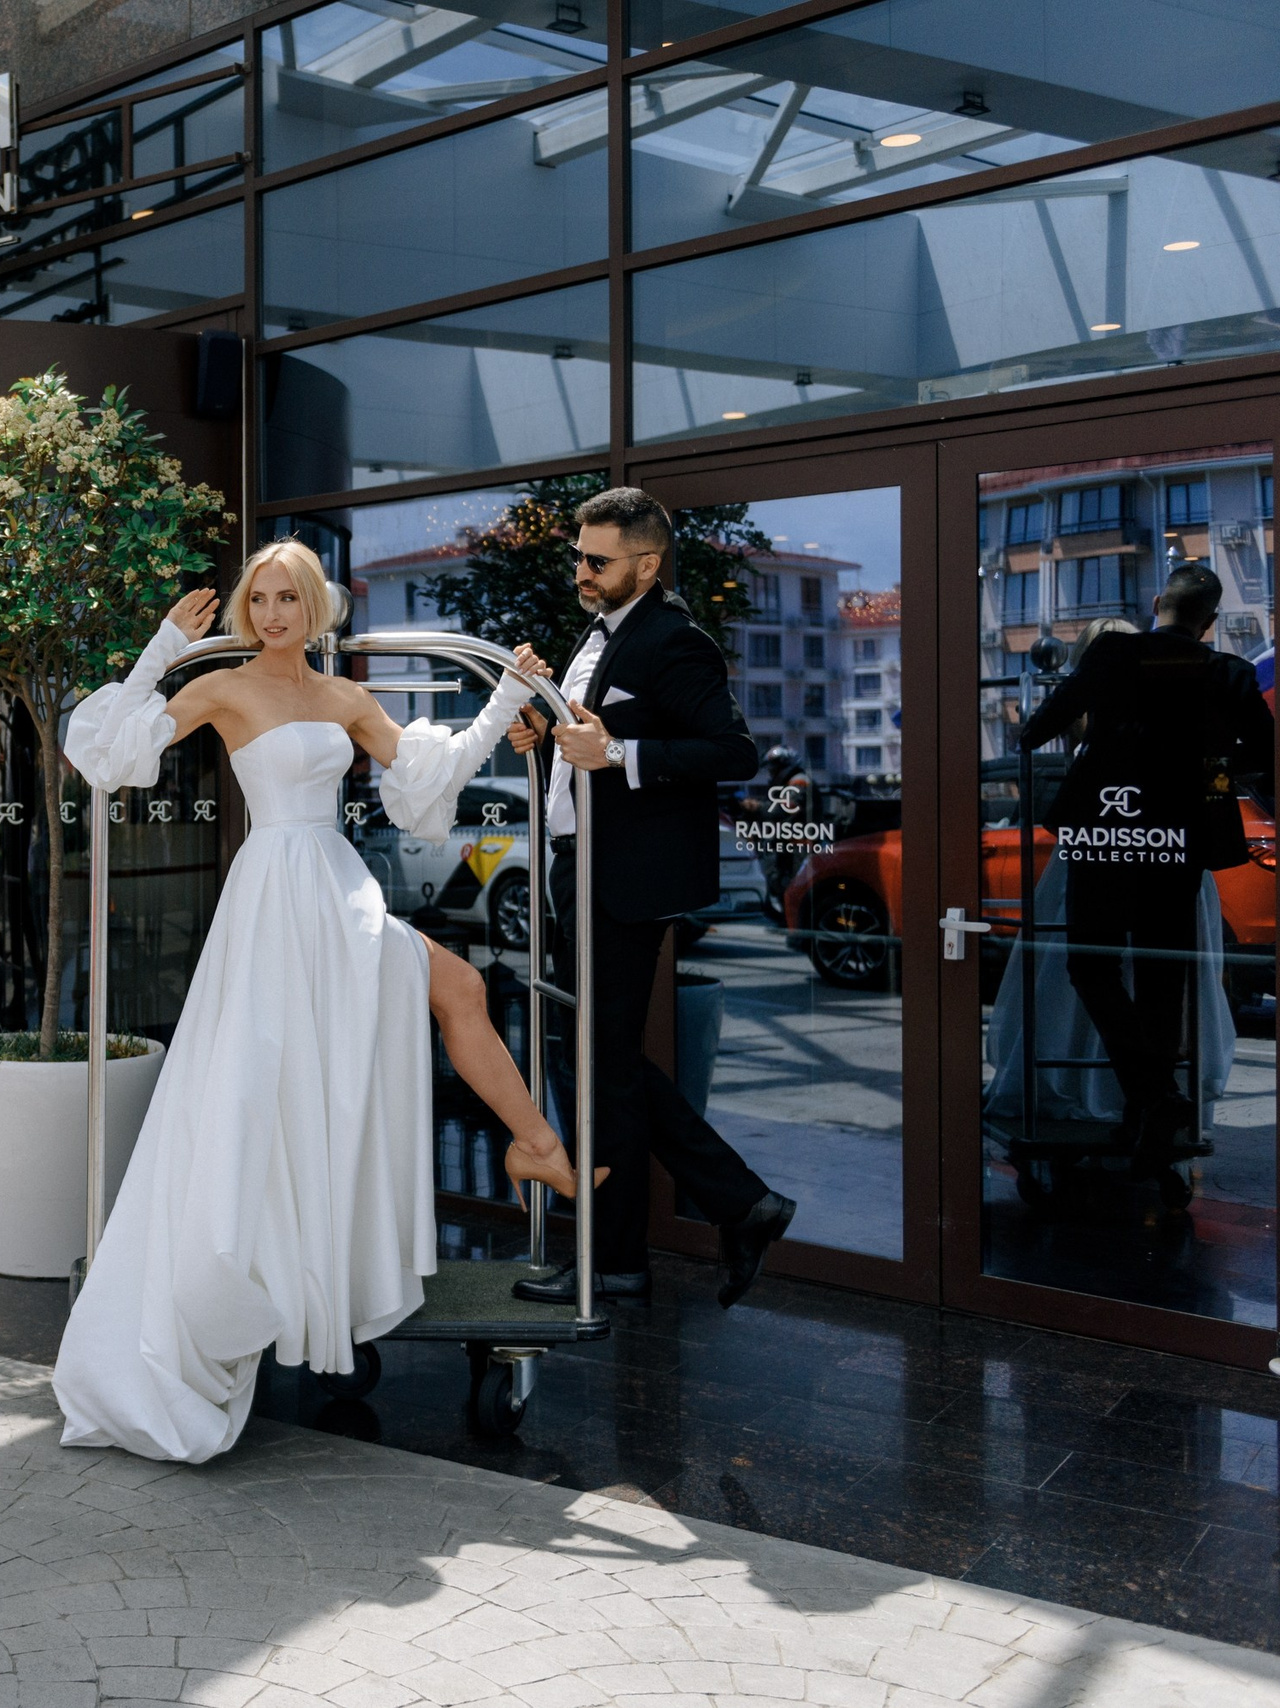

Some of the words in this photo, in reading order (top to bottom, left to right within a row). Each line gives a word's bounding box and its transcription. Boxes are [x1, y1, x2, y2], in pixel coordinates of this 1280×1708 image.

[735, 821, 834, 841] RADISSON
[1058, 826, 1185, 848] RADISSON
[735, 841, 834, 854] COLLECTION
[1058, 849, 1186, 863] COLLECTION
